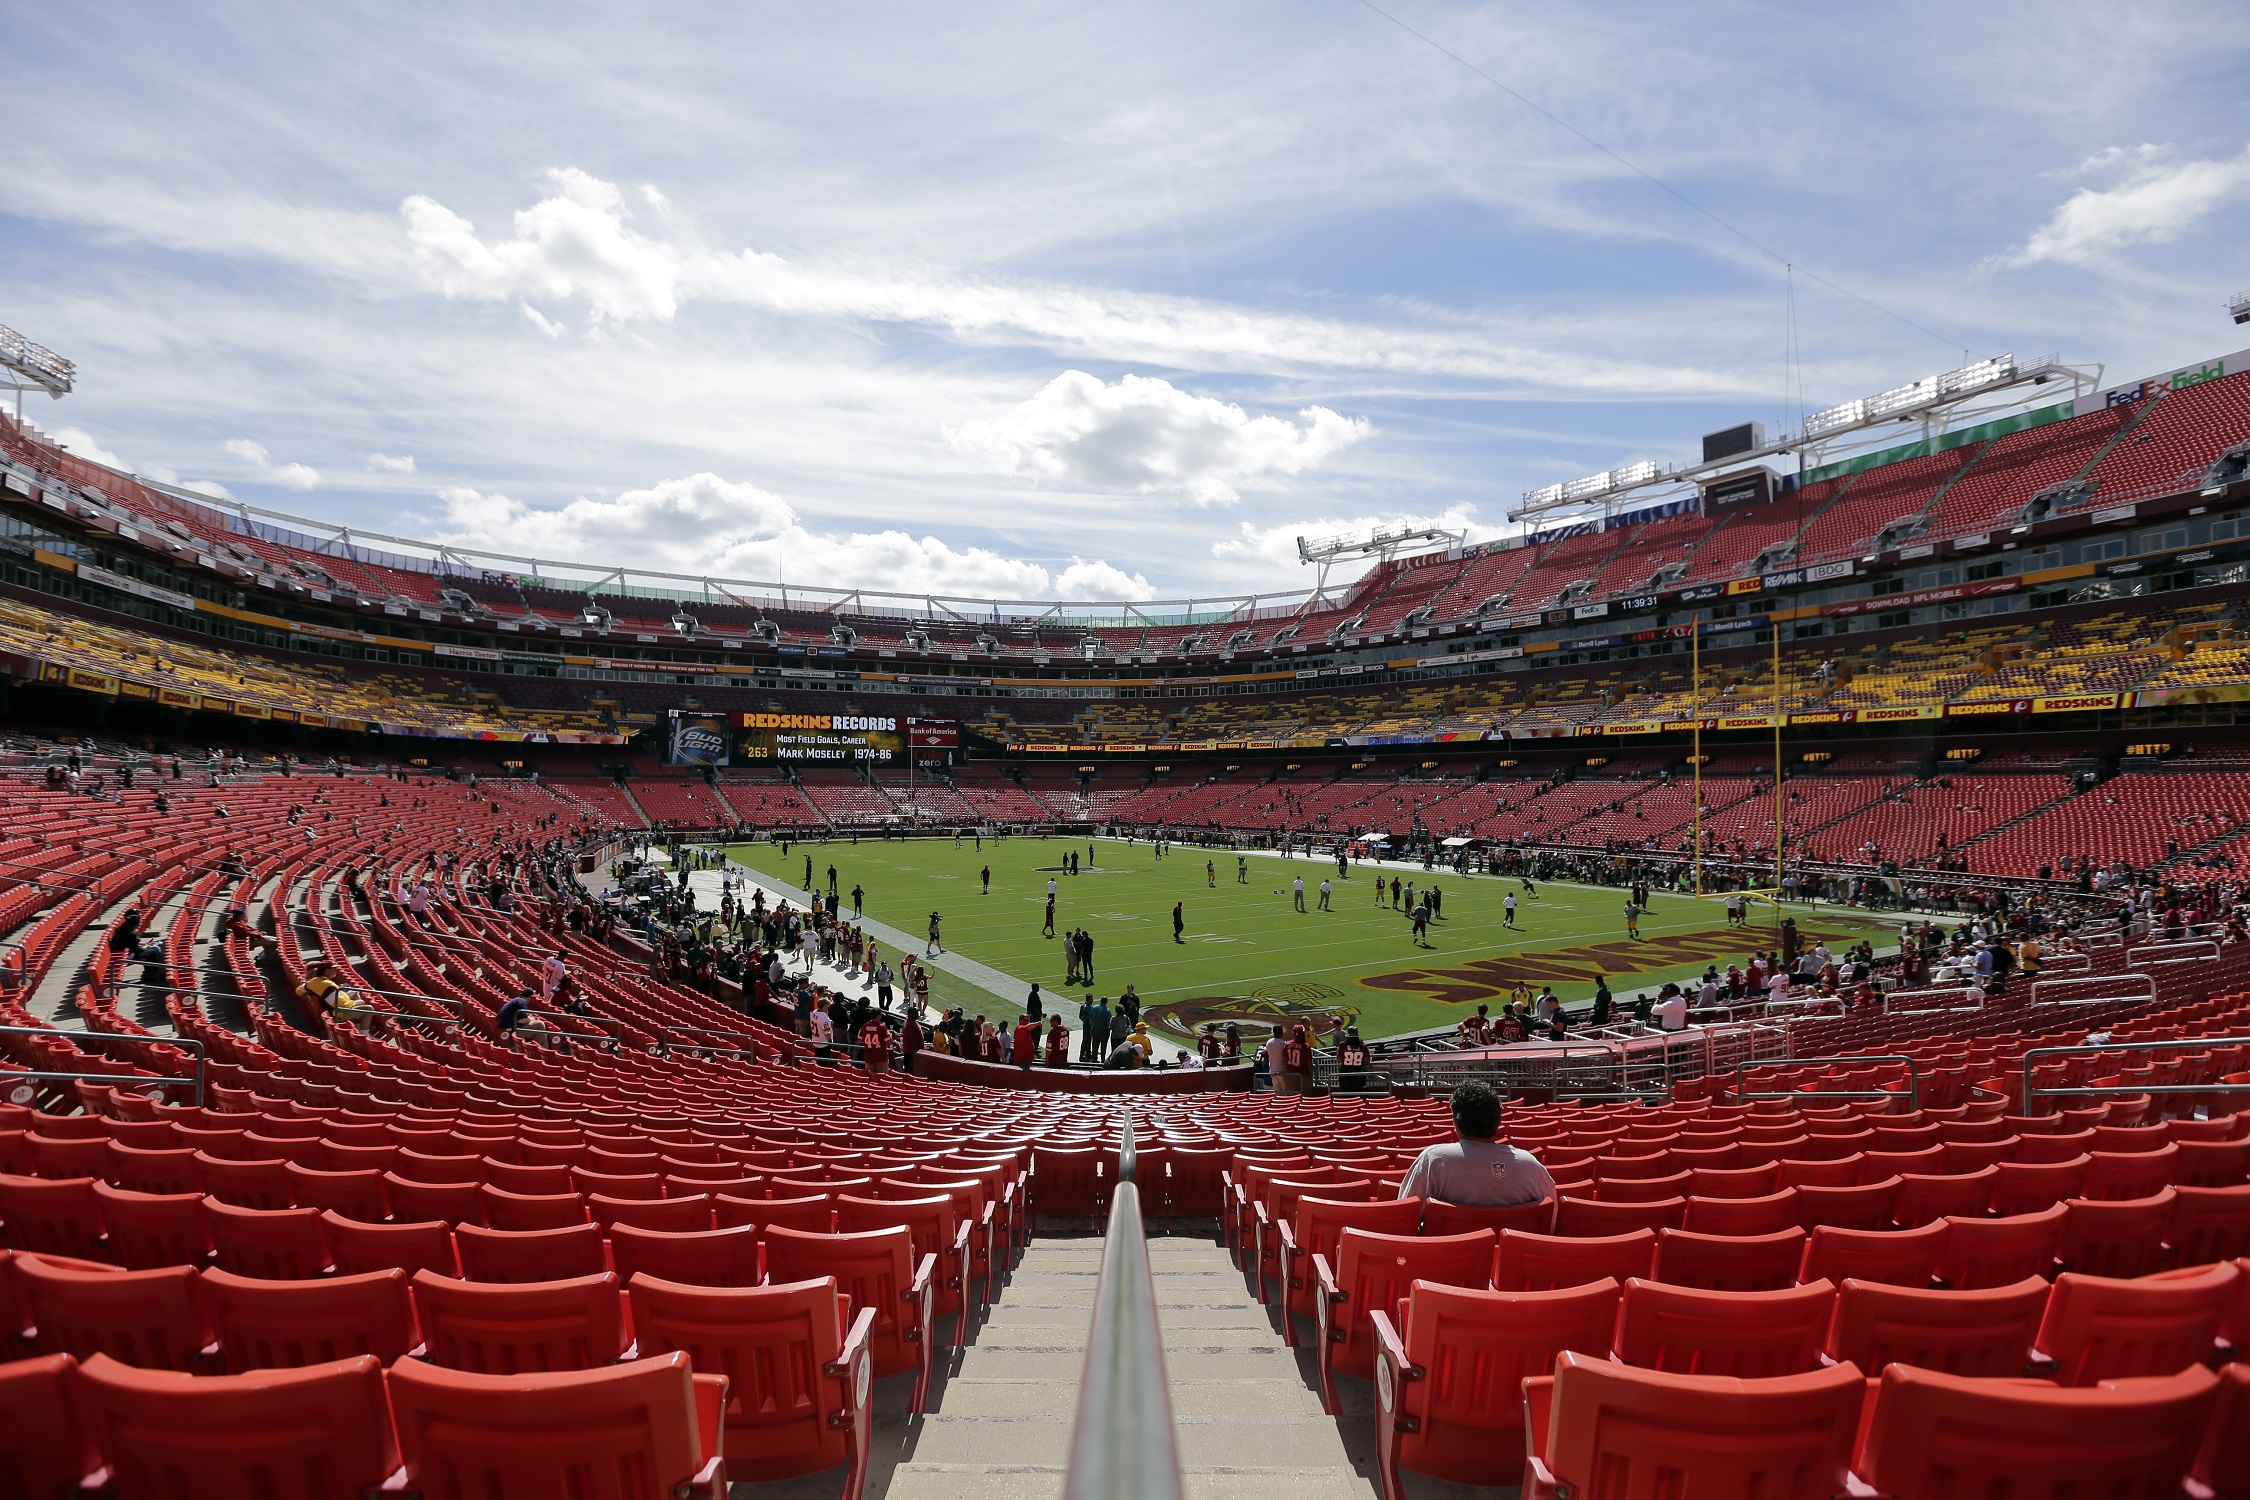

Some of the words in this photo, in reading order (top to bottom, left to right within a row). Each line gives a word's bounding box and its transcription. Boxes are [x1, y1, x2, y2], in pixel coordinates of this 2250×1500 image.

[2106, 360, 2224, 408] FedExField
[1818, 564, 1845, 577] BDO
[1738, 578, 1761, 591] RED
[1621, 596, 1658, 610] 11:39:31
[1866, 596, 1910, 610] DOWNLOAD
[1913, 593, 1929, 603] NFL
[1581, 606, 1600, 614] FedEx
[1714, 622, 1733, 630] Merrill
[1734, 620, 1752, 628] Lynch
[1949, 703, 2011, 715] REDSKINS
[2045, 696, 2114, 710] REDSKINS
[1791, 713, 1840, 724] REDSKINS
[1866, 709, 1919, 720] REDSKINS
[743, 713, 831, 729] REDSKINS
[832, 715, 896, 731] RECORDS
[1725, 718, 1768, 727] REDSKINS
[1609, 725, 1645, 733] REDSKINS
[685, 732, 723, 744] BUD
[776, 735, 797, 743] MOST
[797, 735, 815, 744] FIELD
[817, 736, 841, 745] GOALS,
[842, 736, 866, 745] CAREER
[677, 740, 724, 753] LIGHT
[748, 747, 768, 758] 263
[777, 748, 804, 758] MARK
[806, 748, 846, 759] MOSELEY
[854, 748, 892, 759] 1974-86
[1469, 1027, 1483, 1044] 91
[1502, 1027, 1520, 1041] 47
[864, 1033, 881, 1049] 44
[1201, 1044, 1209, 1059] 11
[1287, 1048, 1301, 1067] 10
[1343, 1051, 1364, 1066] 88
